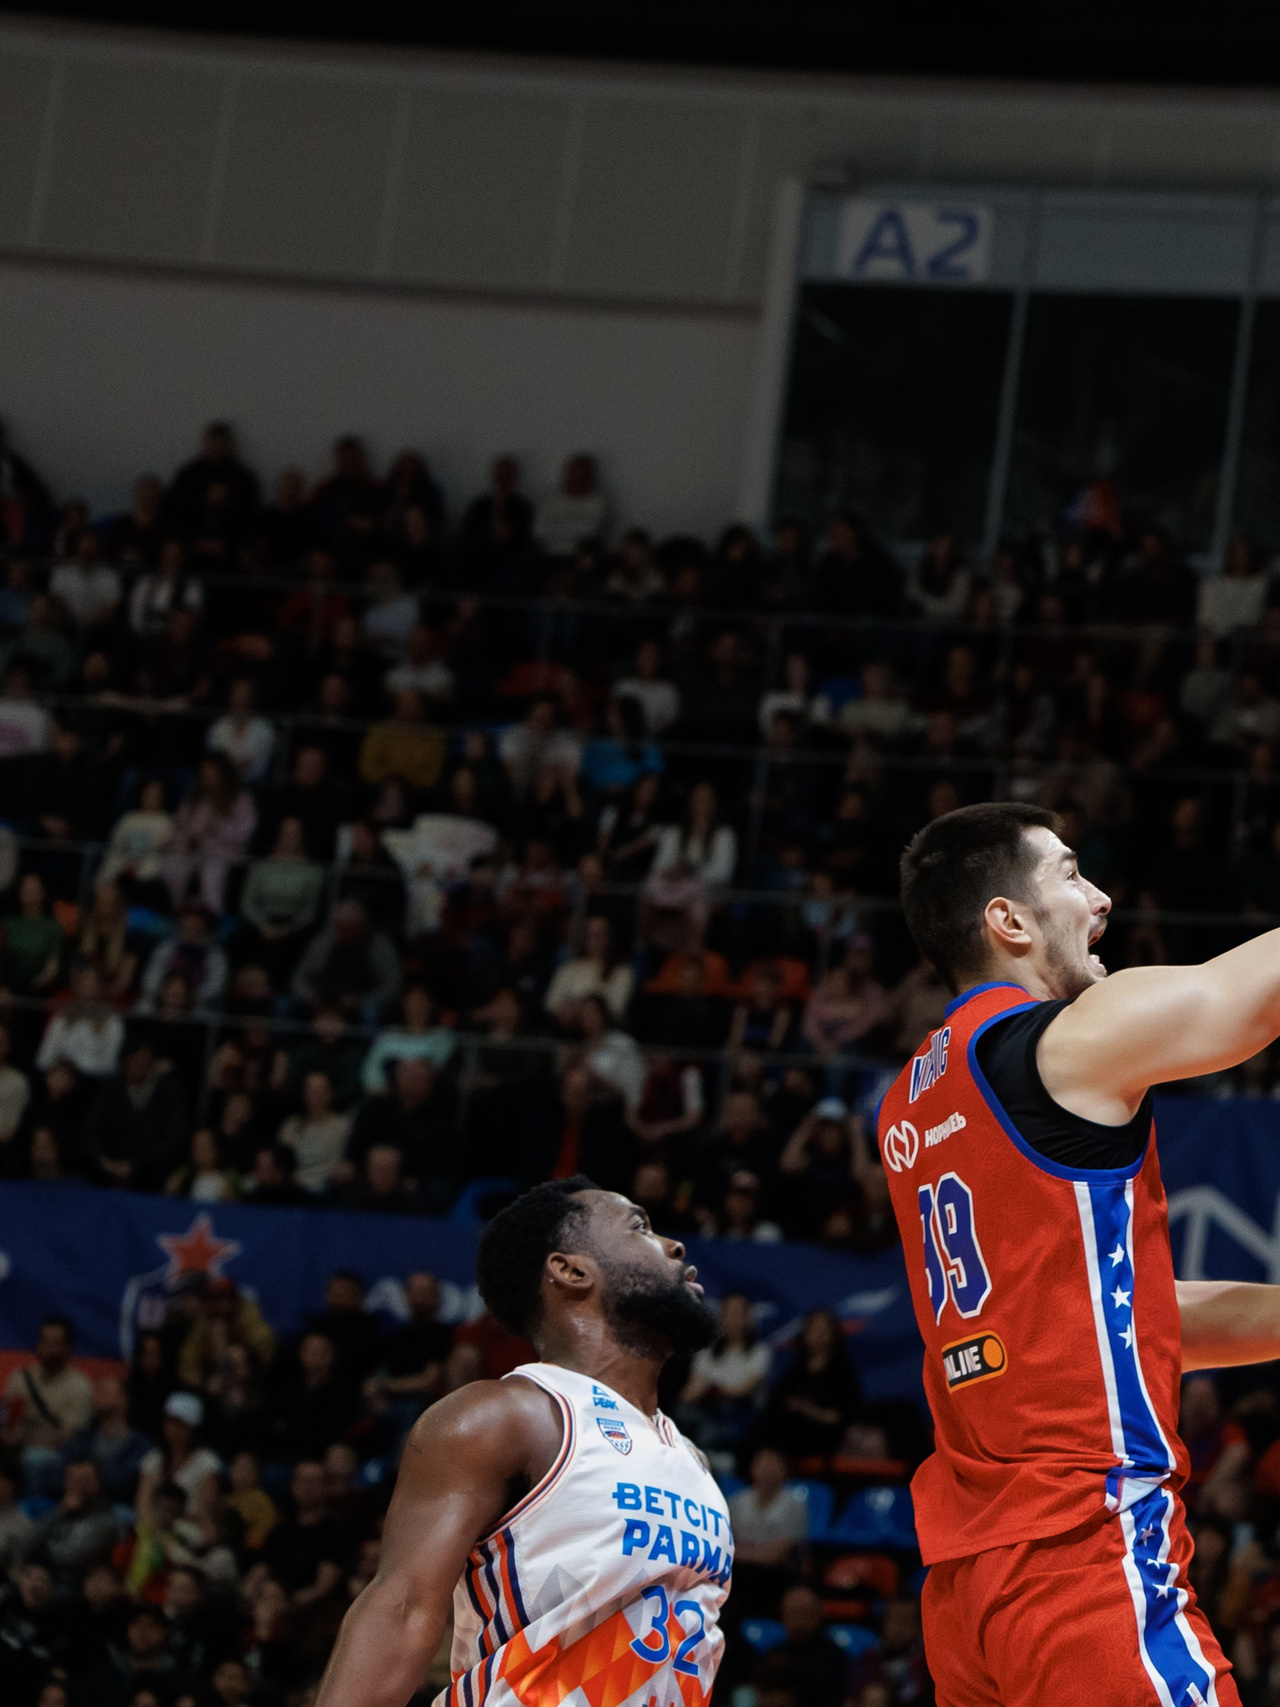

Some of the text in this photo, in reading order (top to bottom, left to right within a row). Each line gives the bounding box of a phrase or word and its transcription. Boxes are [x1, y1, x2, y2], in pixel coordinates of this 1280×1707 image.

[851, 209, 980, 281] A2
[622, 1518, 732, 1588] PARMA
[629, 1584, 706, 1677] 32
